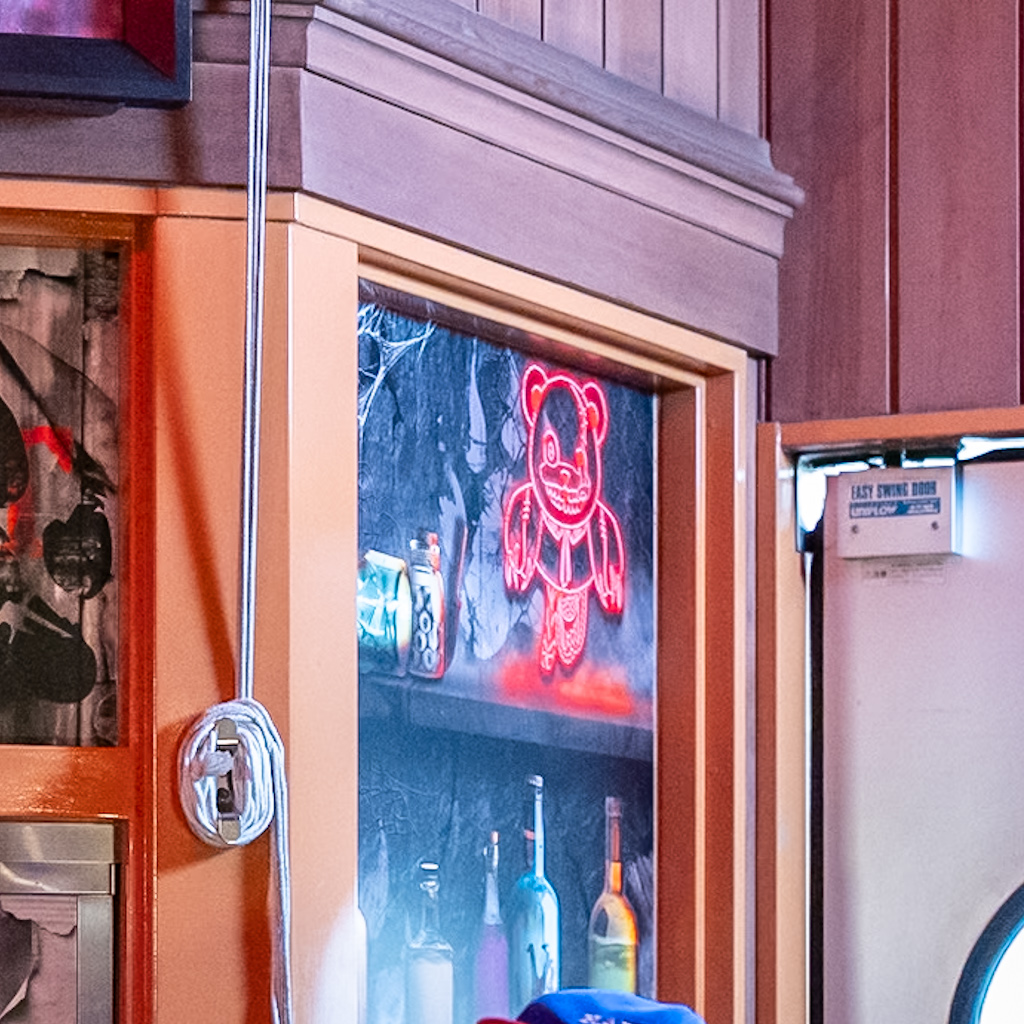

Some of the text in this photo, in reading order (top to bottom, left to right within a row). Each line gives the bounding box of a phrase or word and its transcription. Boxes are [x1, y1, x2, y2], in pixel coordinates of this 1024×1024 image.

[852, 481, 937, 499] EASY SWING DOOR
